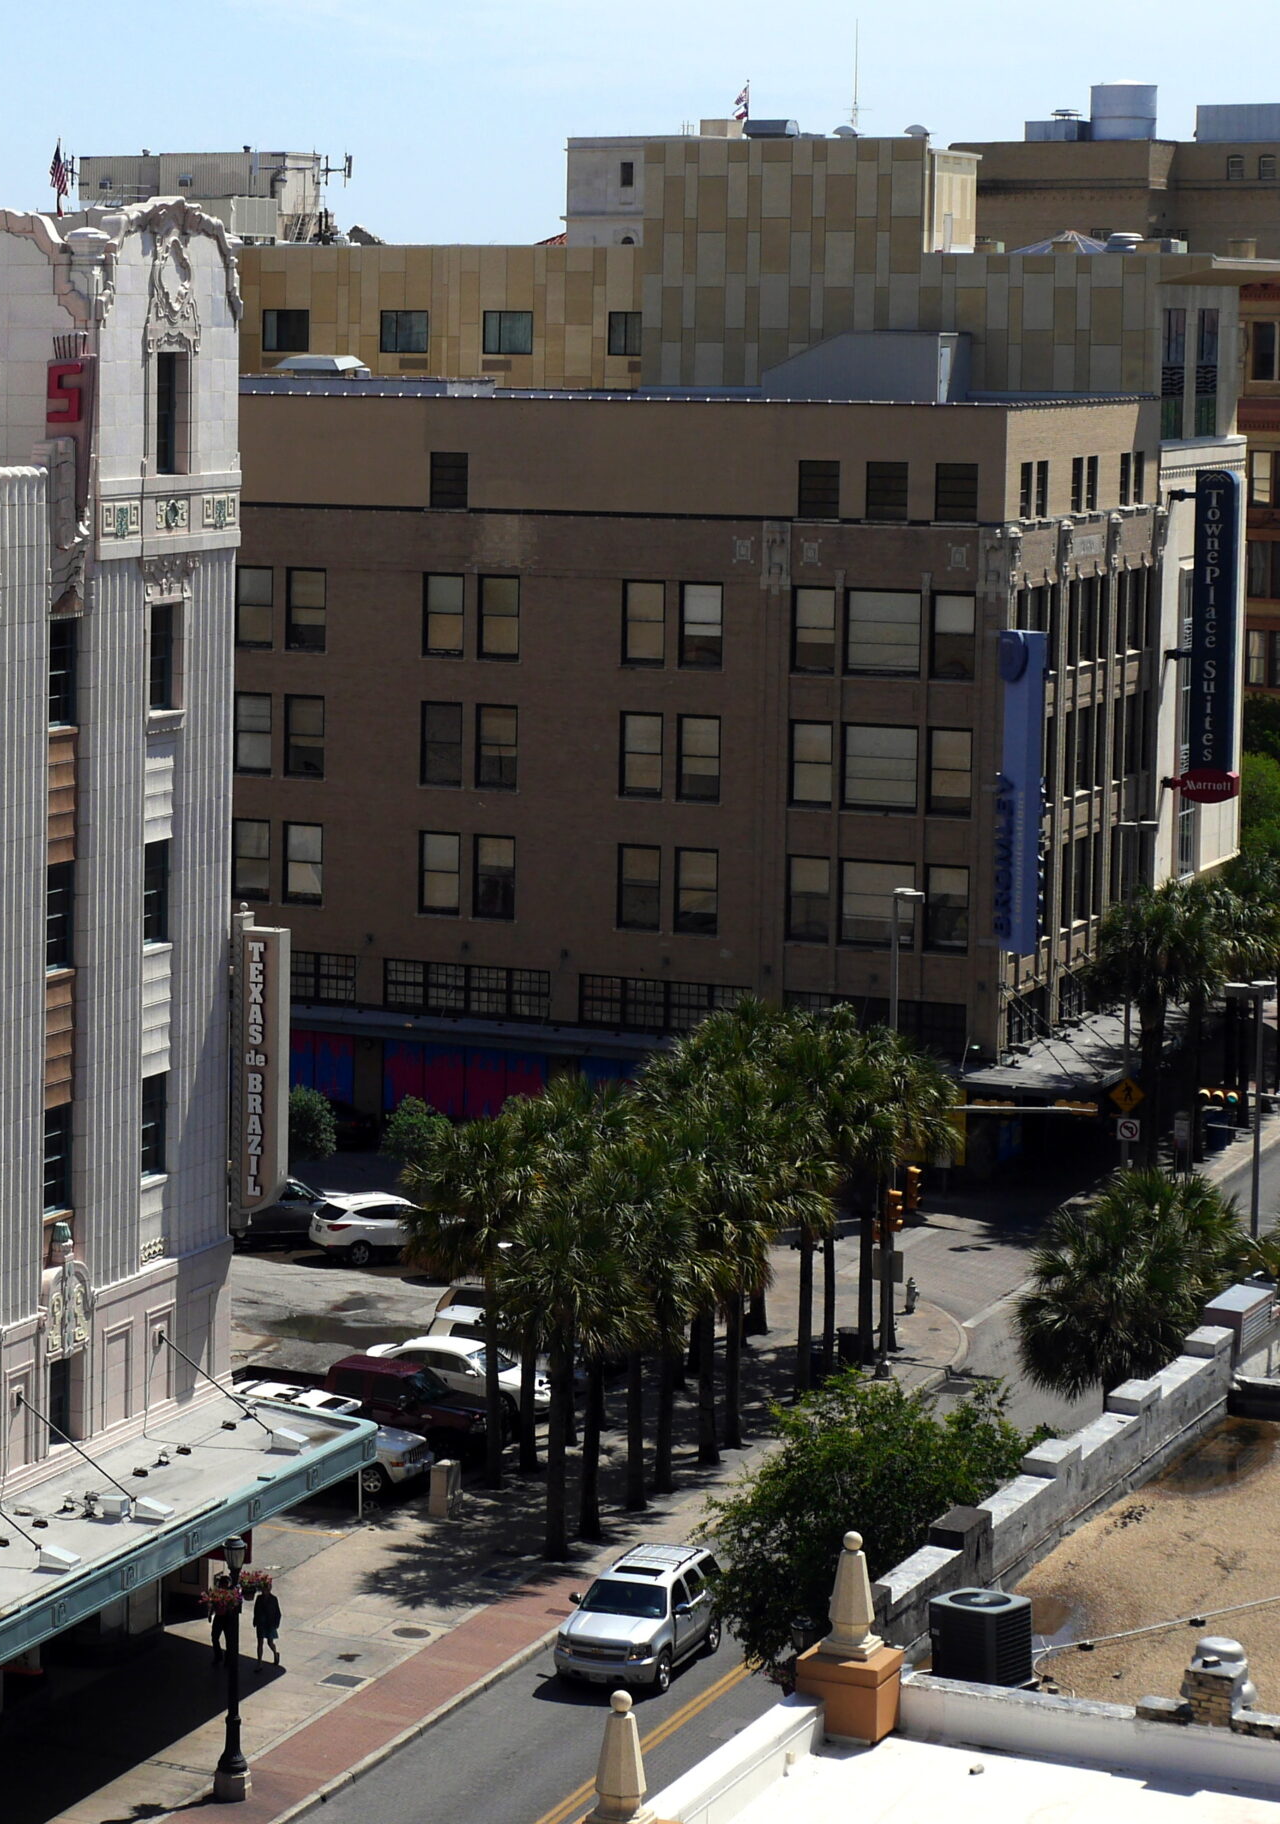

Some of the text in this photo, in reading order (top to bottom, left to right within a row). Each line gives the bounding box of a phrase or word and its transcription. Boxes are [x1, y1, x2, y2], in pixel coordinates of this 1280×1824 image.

[1202, 489, 1224, 762] TownePlace Suites
[992, 776, 1014, 938] BROMLEY
[1183, 779, 1232, 792] Marriott
[245, 942, 266, 1197] TEXAS de BRAZIL
